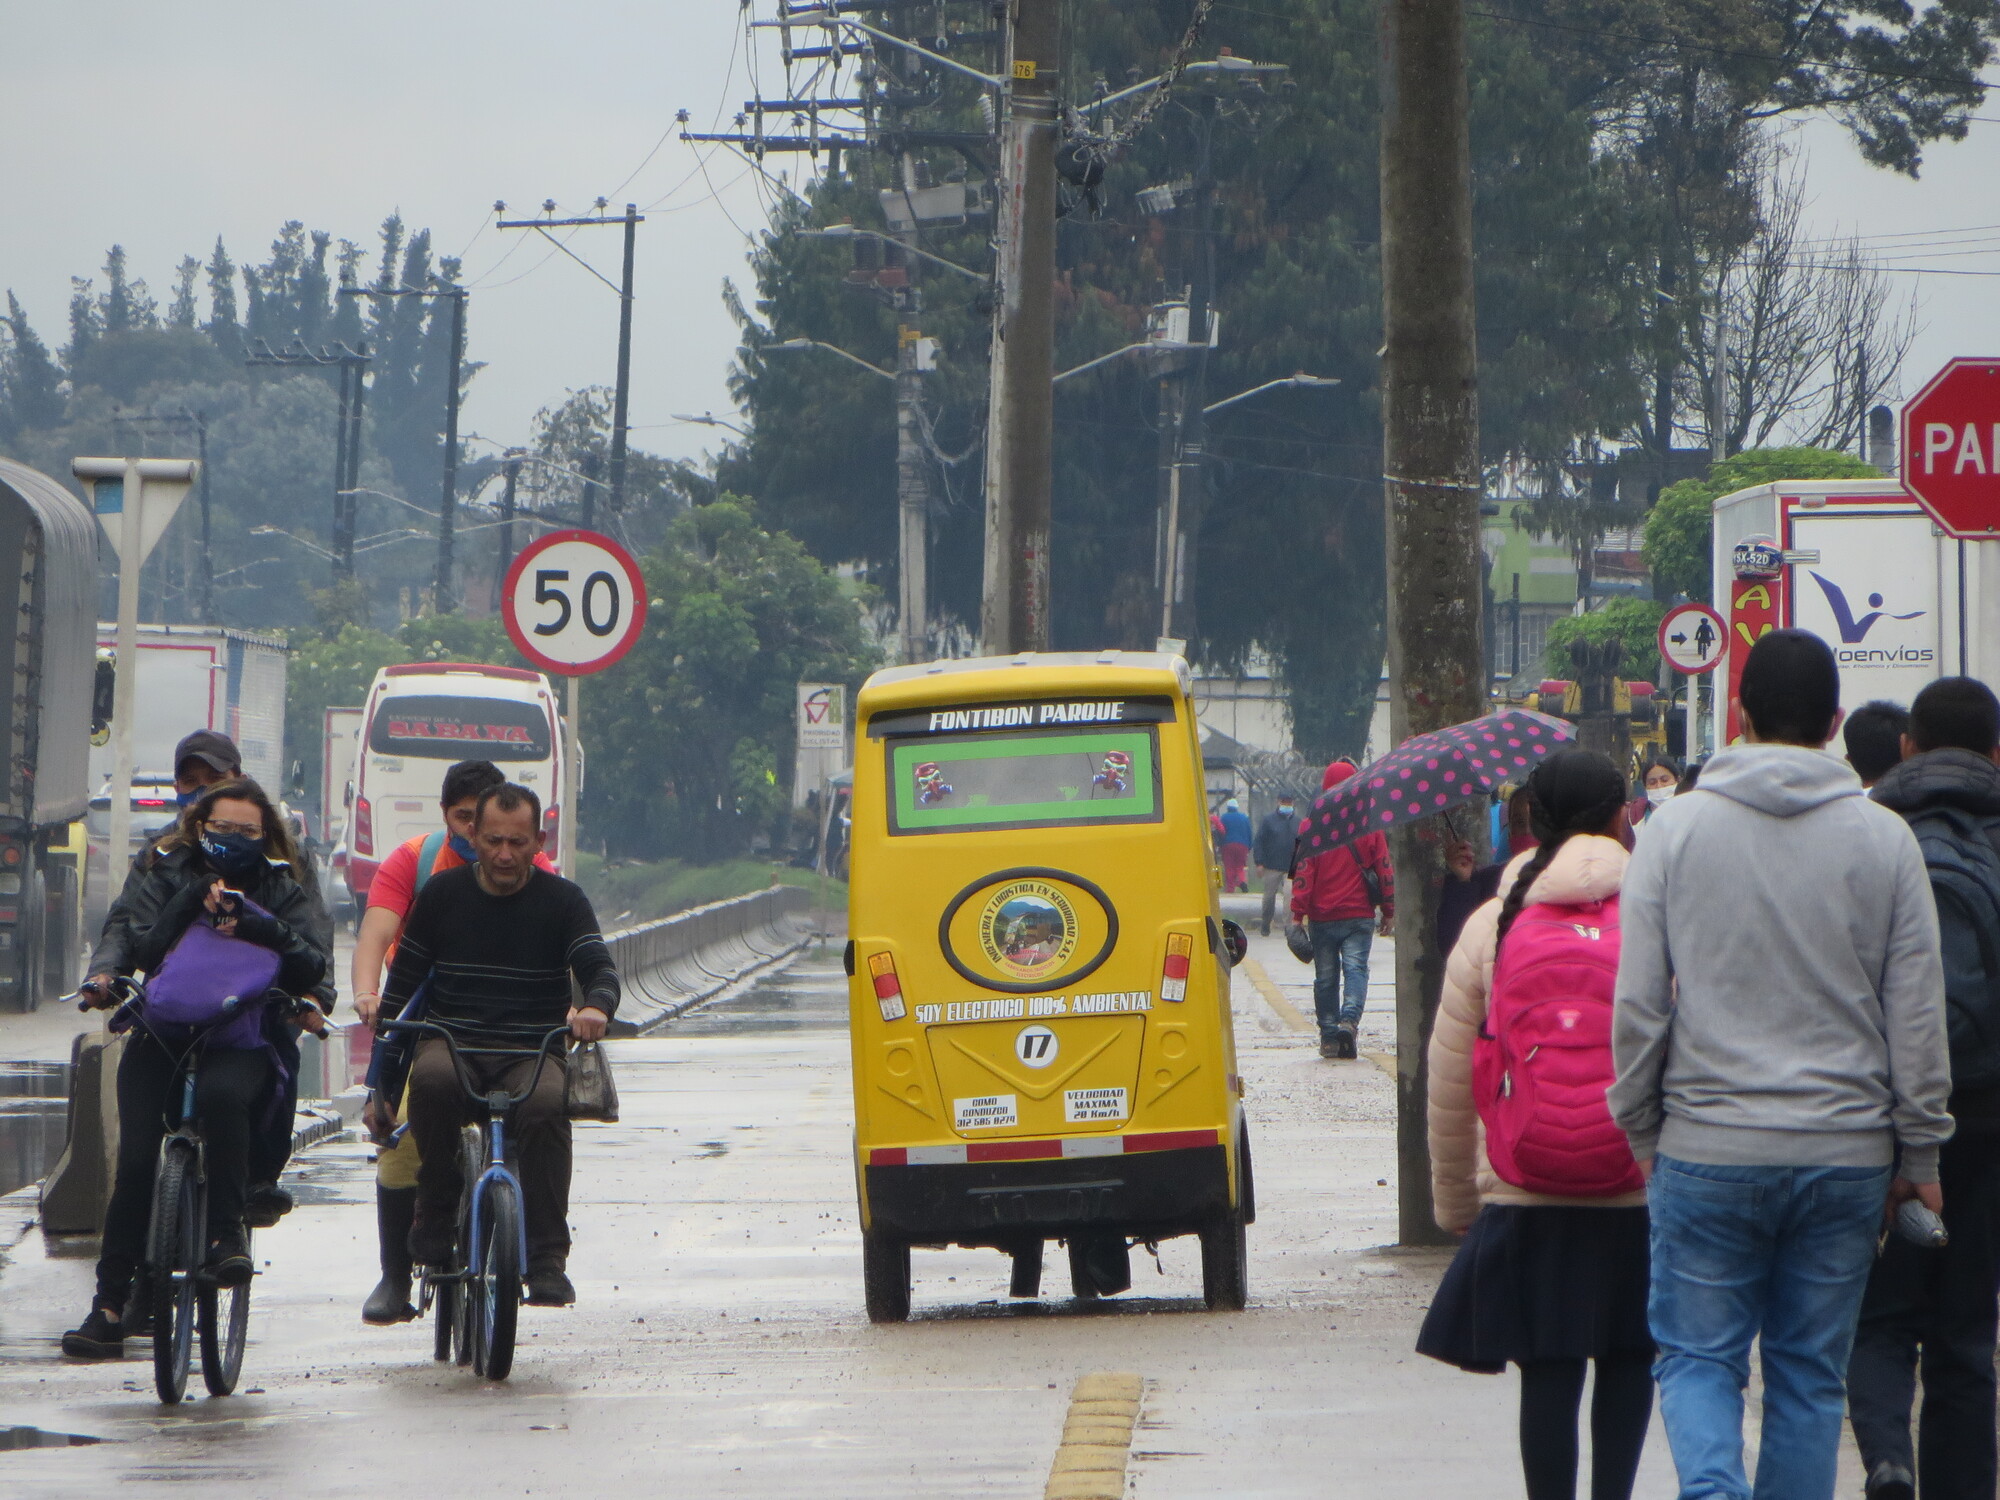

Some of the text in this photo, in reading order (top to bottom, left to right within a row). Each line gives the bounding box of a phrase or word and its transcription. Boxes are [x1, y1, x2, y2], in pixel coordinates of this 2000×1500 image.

[1924, 422, 2000, 475] PA
[533, 569, 620, 637] 50
[1834, 644, 1934, 662] oenvíos
[929, 701, 1125, 731] FONTIBON PARQUE
[388, 721, 534, 744] SABANA
[1036, 885, 1050, 895] EN
[915, 991, 1153, 1024] SOY ELECTRICO 100% AMBIENTAL
[1022, 1034, 1053, 1059] 17
[1067, 1089, 1124, 1100] VELOCIDAD
[972, 1097, 998, 1107] COMO
[1074, 1099, 1118, 1109] MAXIMA
[962, 1106, 1009, 1117] CONDUZCO
[1090, 1109, 1120, 1118] Km/h
[956, 1118, 972, 1128] 312
